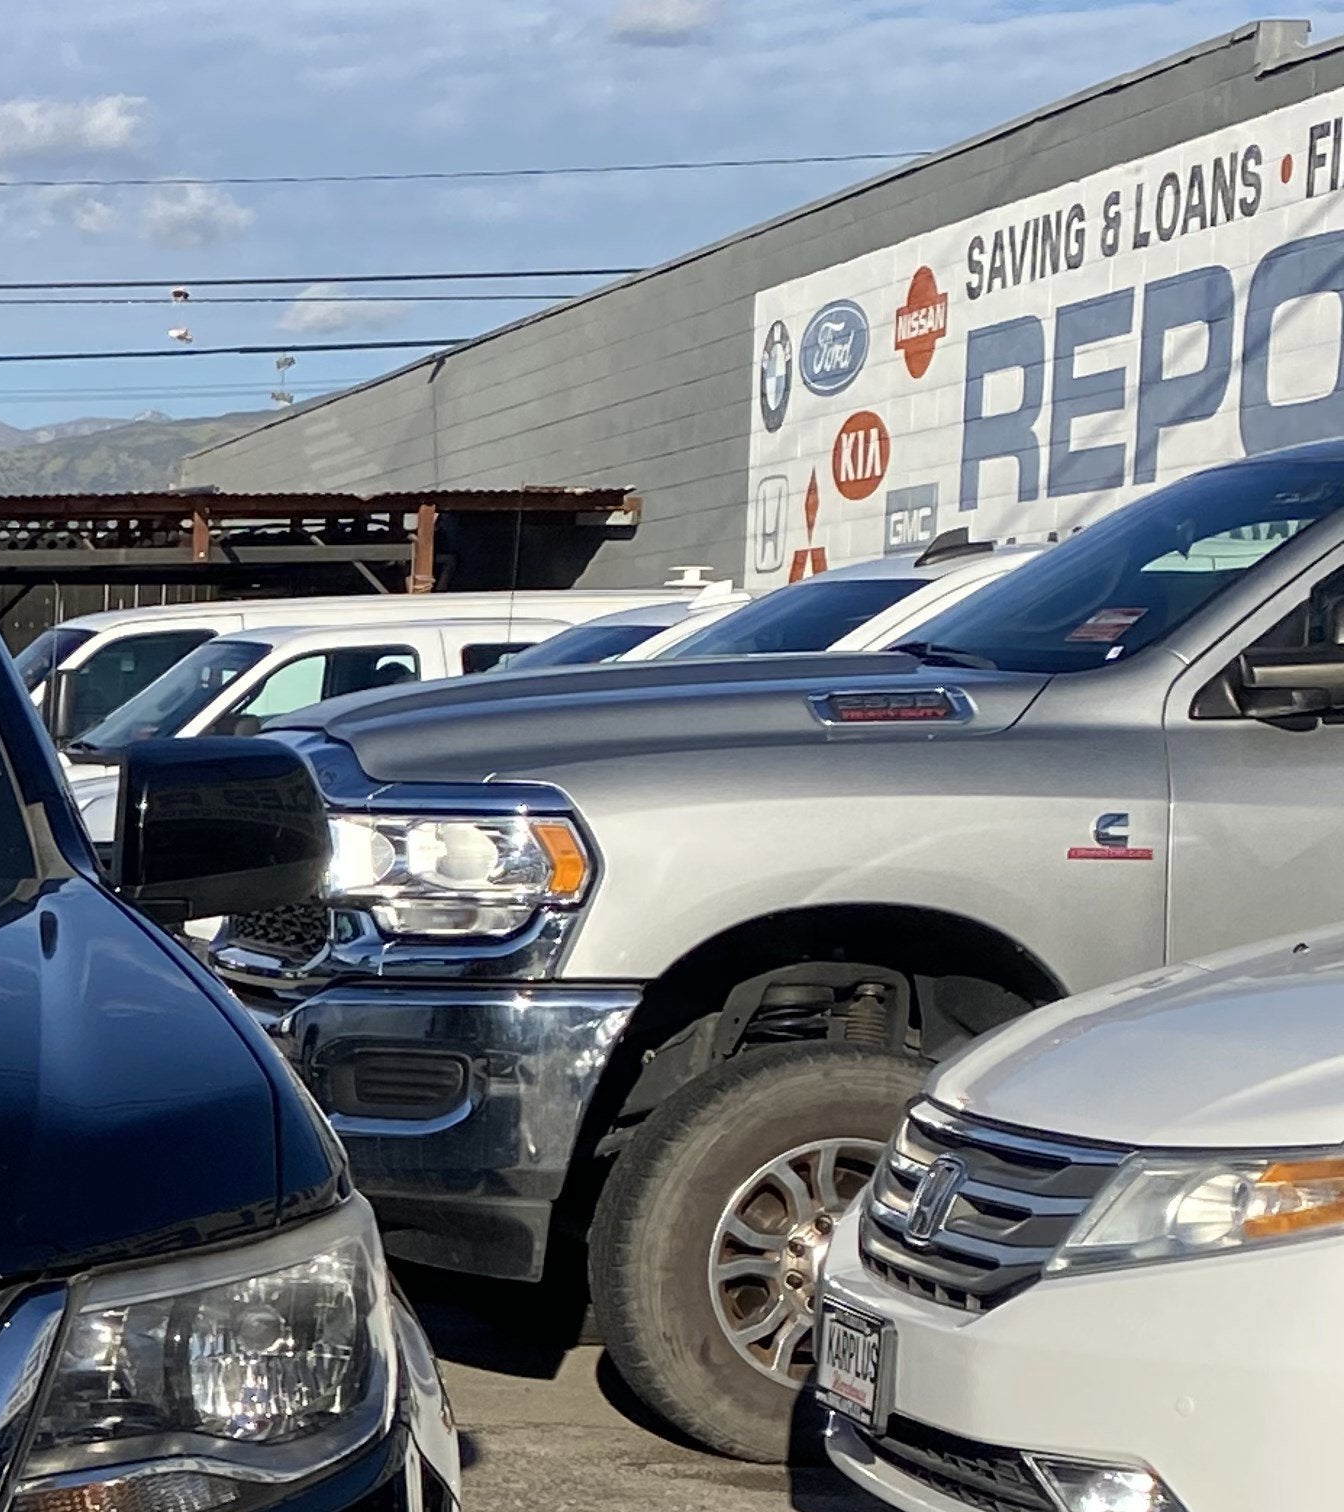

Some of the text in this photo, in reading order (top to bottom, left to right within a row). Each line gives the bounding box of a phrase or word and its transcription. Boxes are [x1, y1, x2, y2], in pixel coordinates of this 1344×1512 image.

[965, 116, 1344, 300] SAVING & LOANS FI
[812, 320, 855, 375] Ford
[897, 302, 947, 343] NISSAN
[959, 230, 1344, 513] REPO
[840, 426, 882, 482] KIA
[888, 506, 932, 546] GMC
[826, 1320, 878, 1384] KARPLUS
